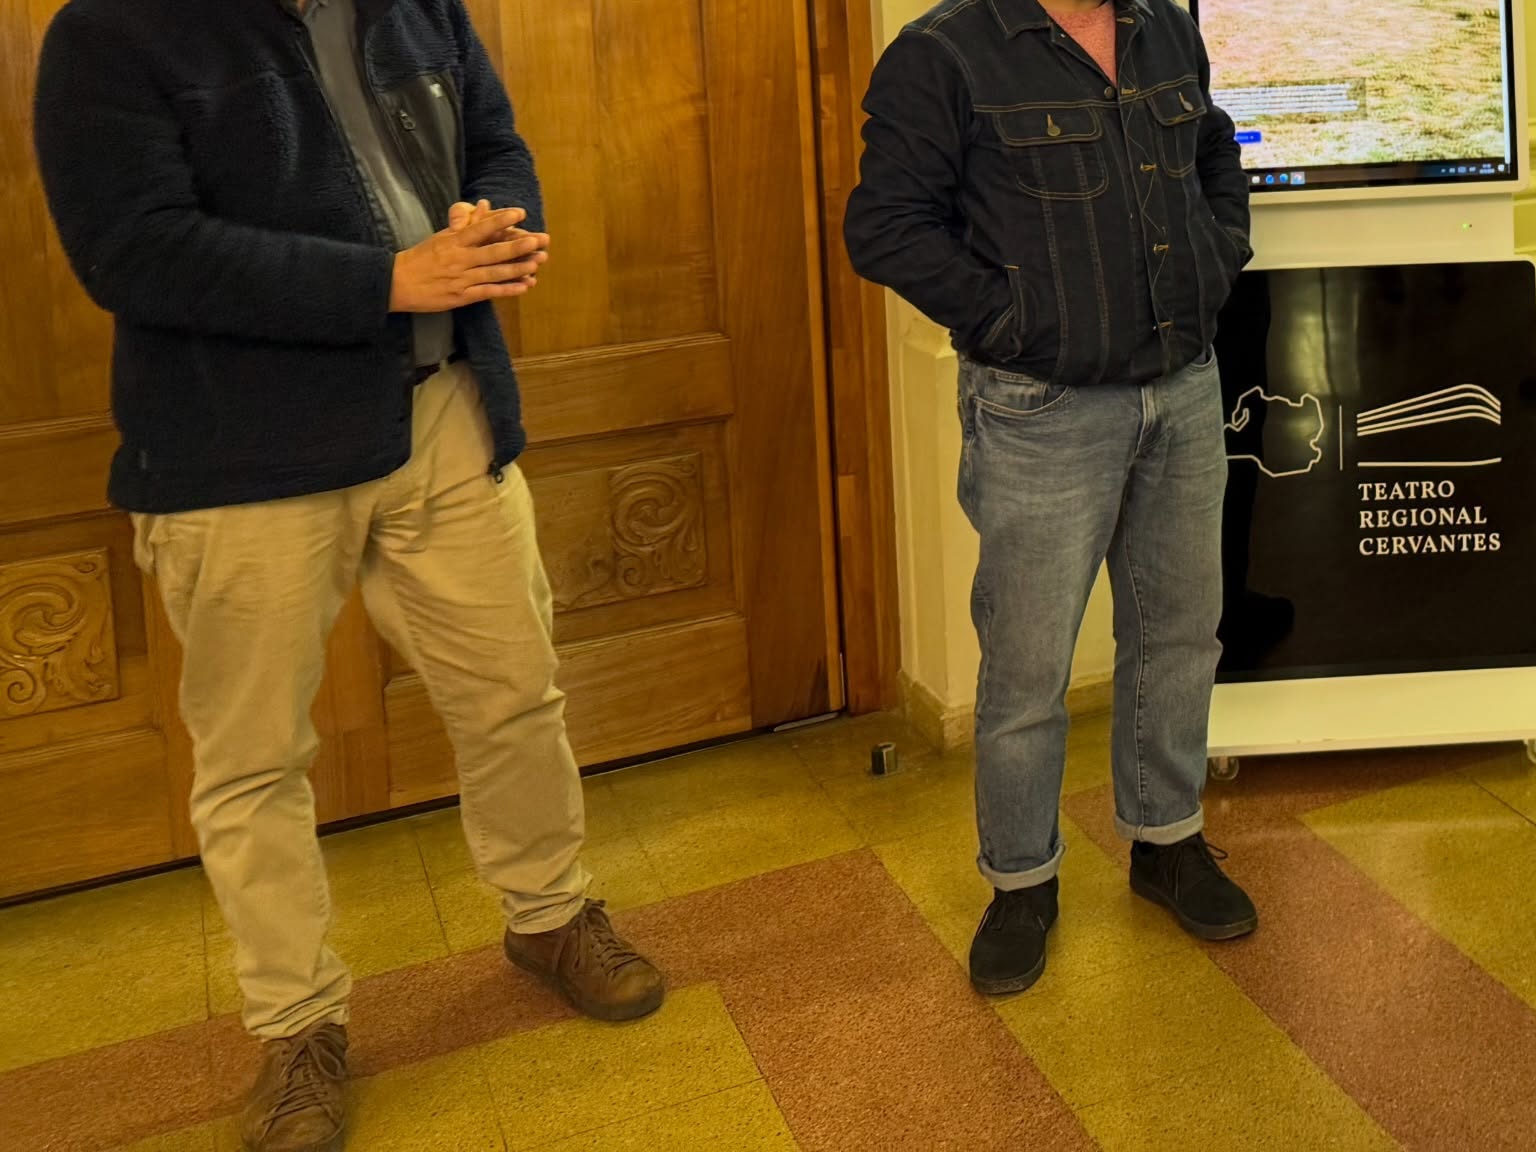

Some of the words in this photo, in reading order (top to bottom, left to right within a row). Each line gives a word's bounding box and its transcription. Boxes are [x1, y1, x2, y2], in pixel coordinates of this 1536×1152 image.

[1358, 480, 1455, 501] TEATRO
[1359, 506, 1487, 529] REGIONAL
[1359, 532, 1501, 555] CERVANTES
